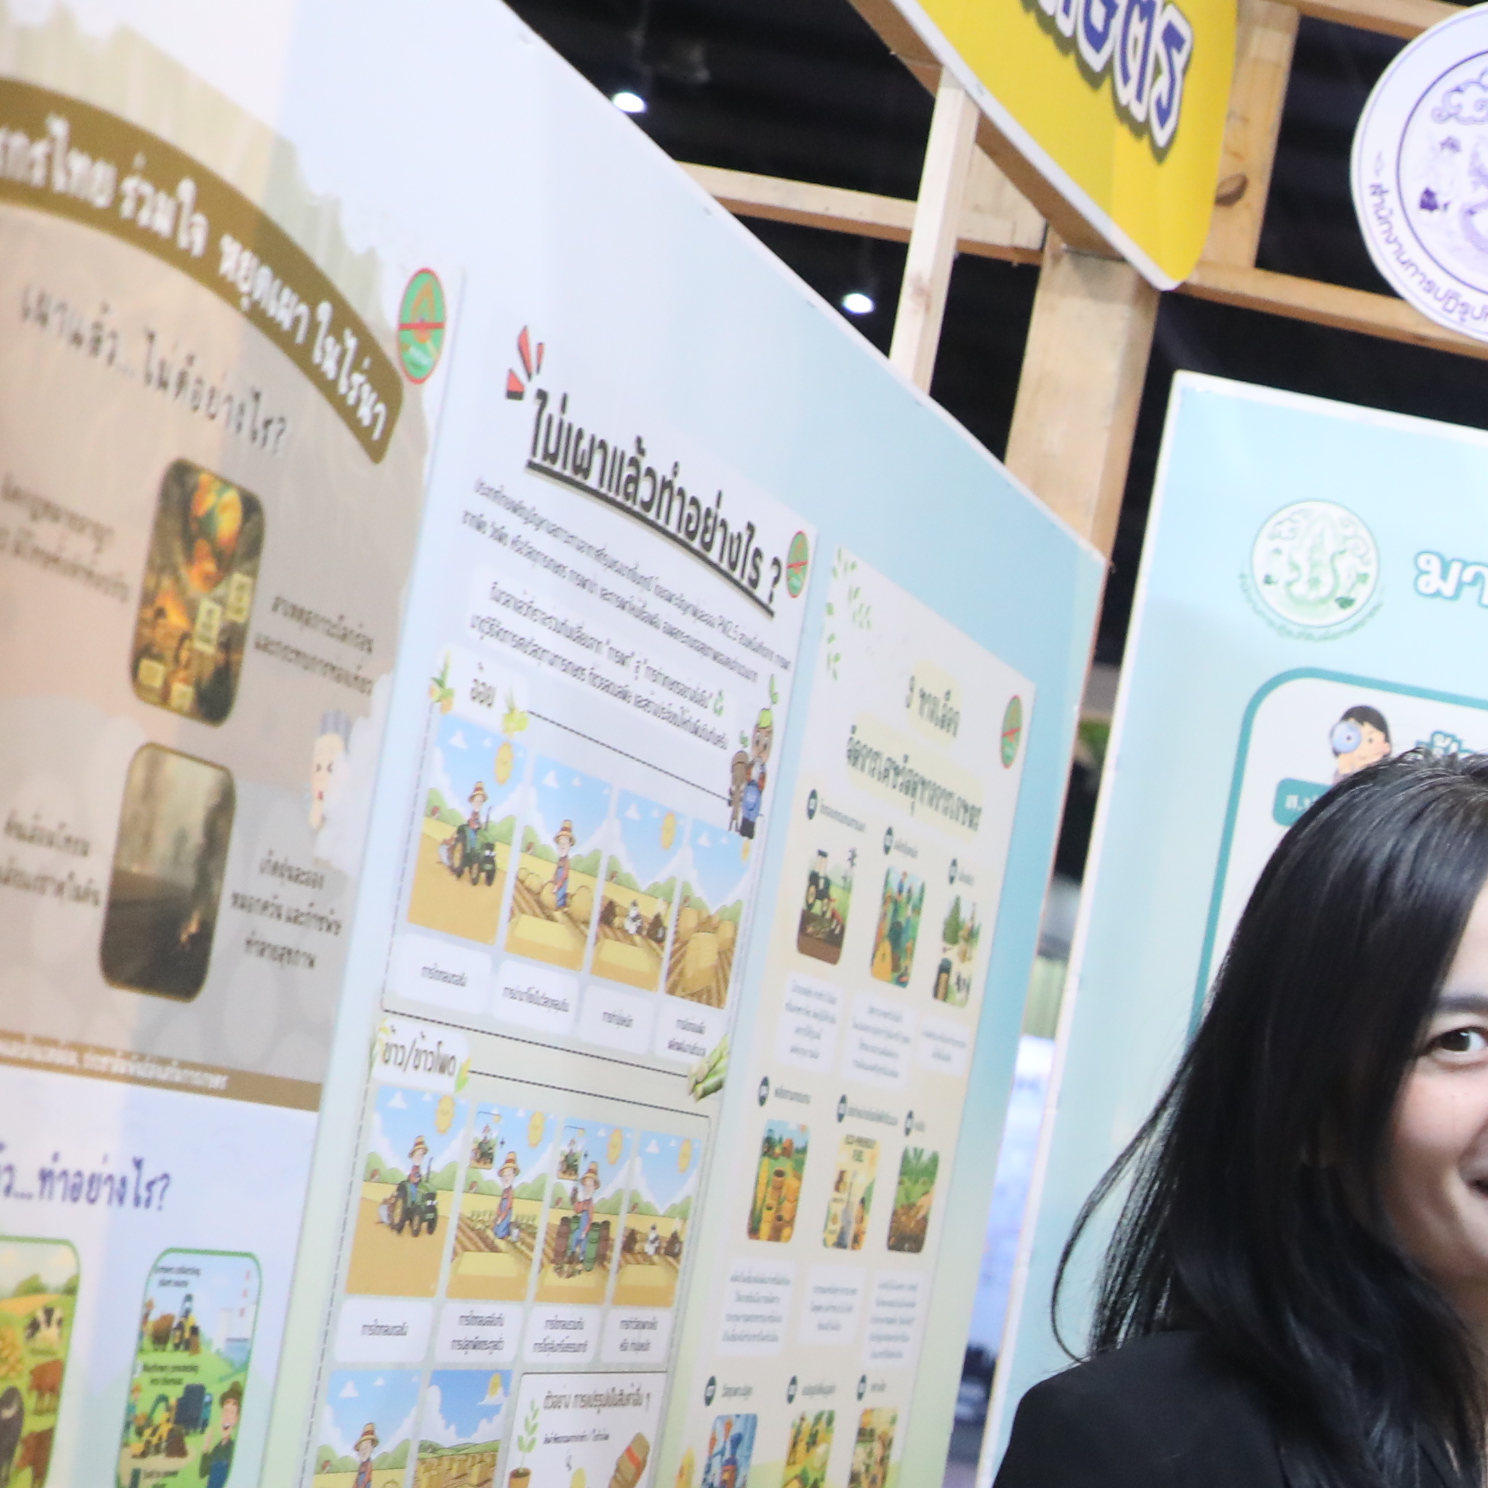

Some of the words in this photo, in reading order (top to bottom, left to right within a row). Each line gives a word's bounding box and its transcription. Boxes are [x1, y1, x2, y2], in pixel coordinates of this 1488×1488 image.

[1040, 0, 1194, 146] ษตร
[0, 112, 118, 209] กรไทย
[530, 387, 765, 592] ไม่เผาแล้วทำอย่างไร
[765, 555, 782, 605] ?
[0, 1141, 171, 1213] ว...ทำอย่างไร?
